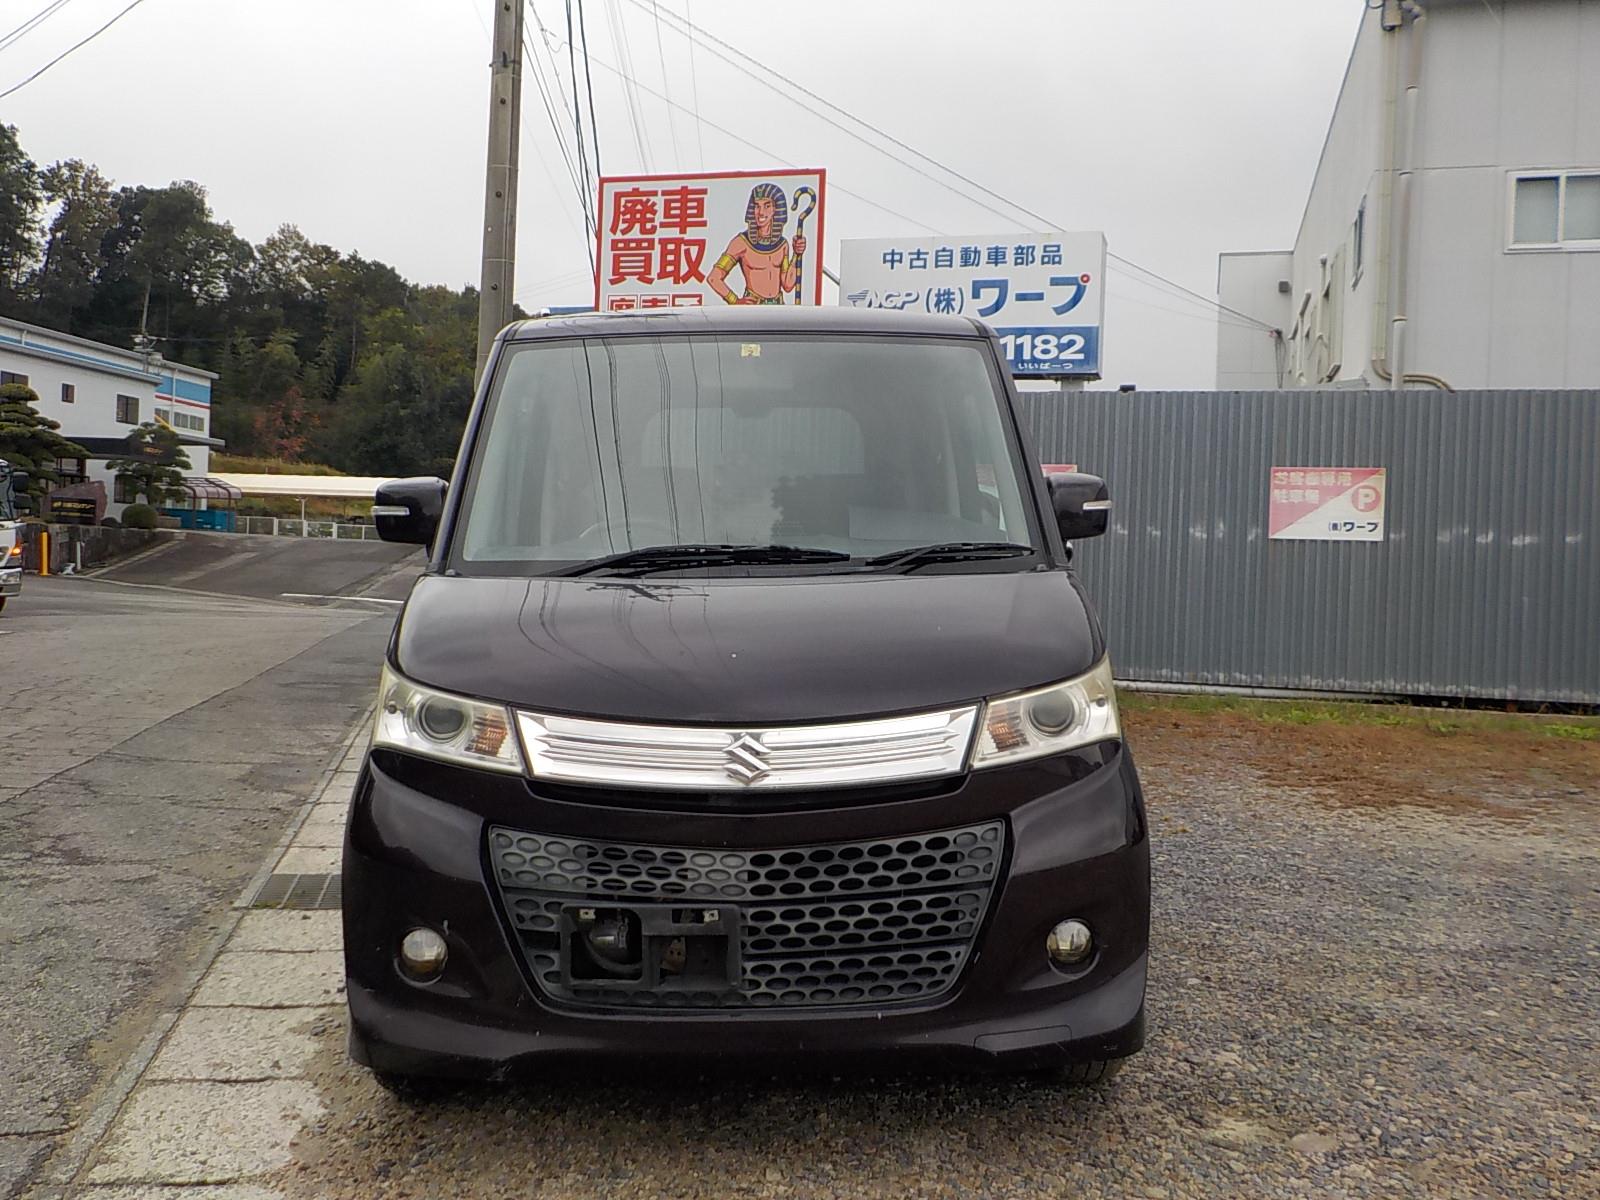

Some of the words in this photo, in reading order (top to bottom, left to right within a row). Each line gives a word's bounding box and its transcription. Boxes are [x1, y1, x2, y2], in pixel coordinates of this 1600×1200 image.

[610, 186, 708, 236] 廃車
[608, 237, 707, 286] 買取
[882, 244, 1063, 270] 中古自動車部品
[1358, 488, 1377, 510] P
